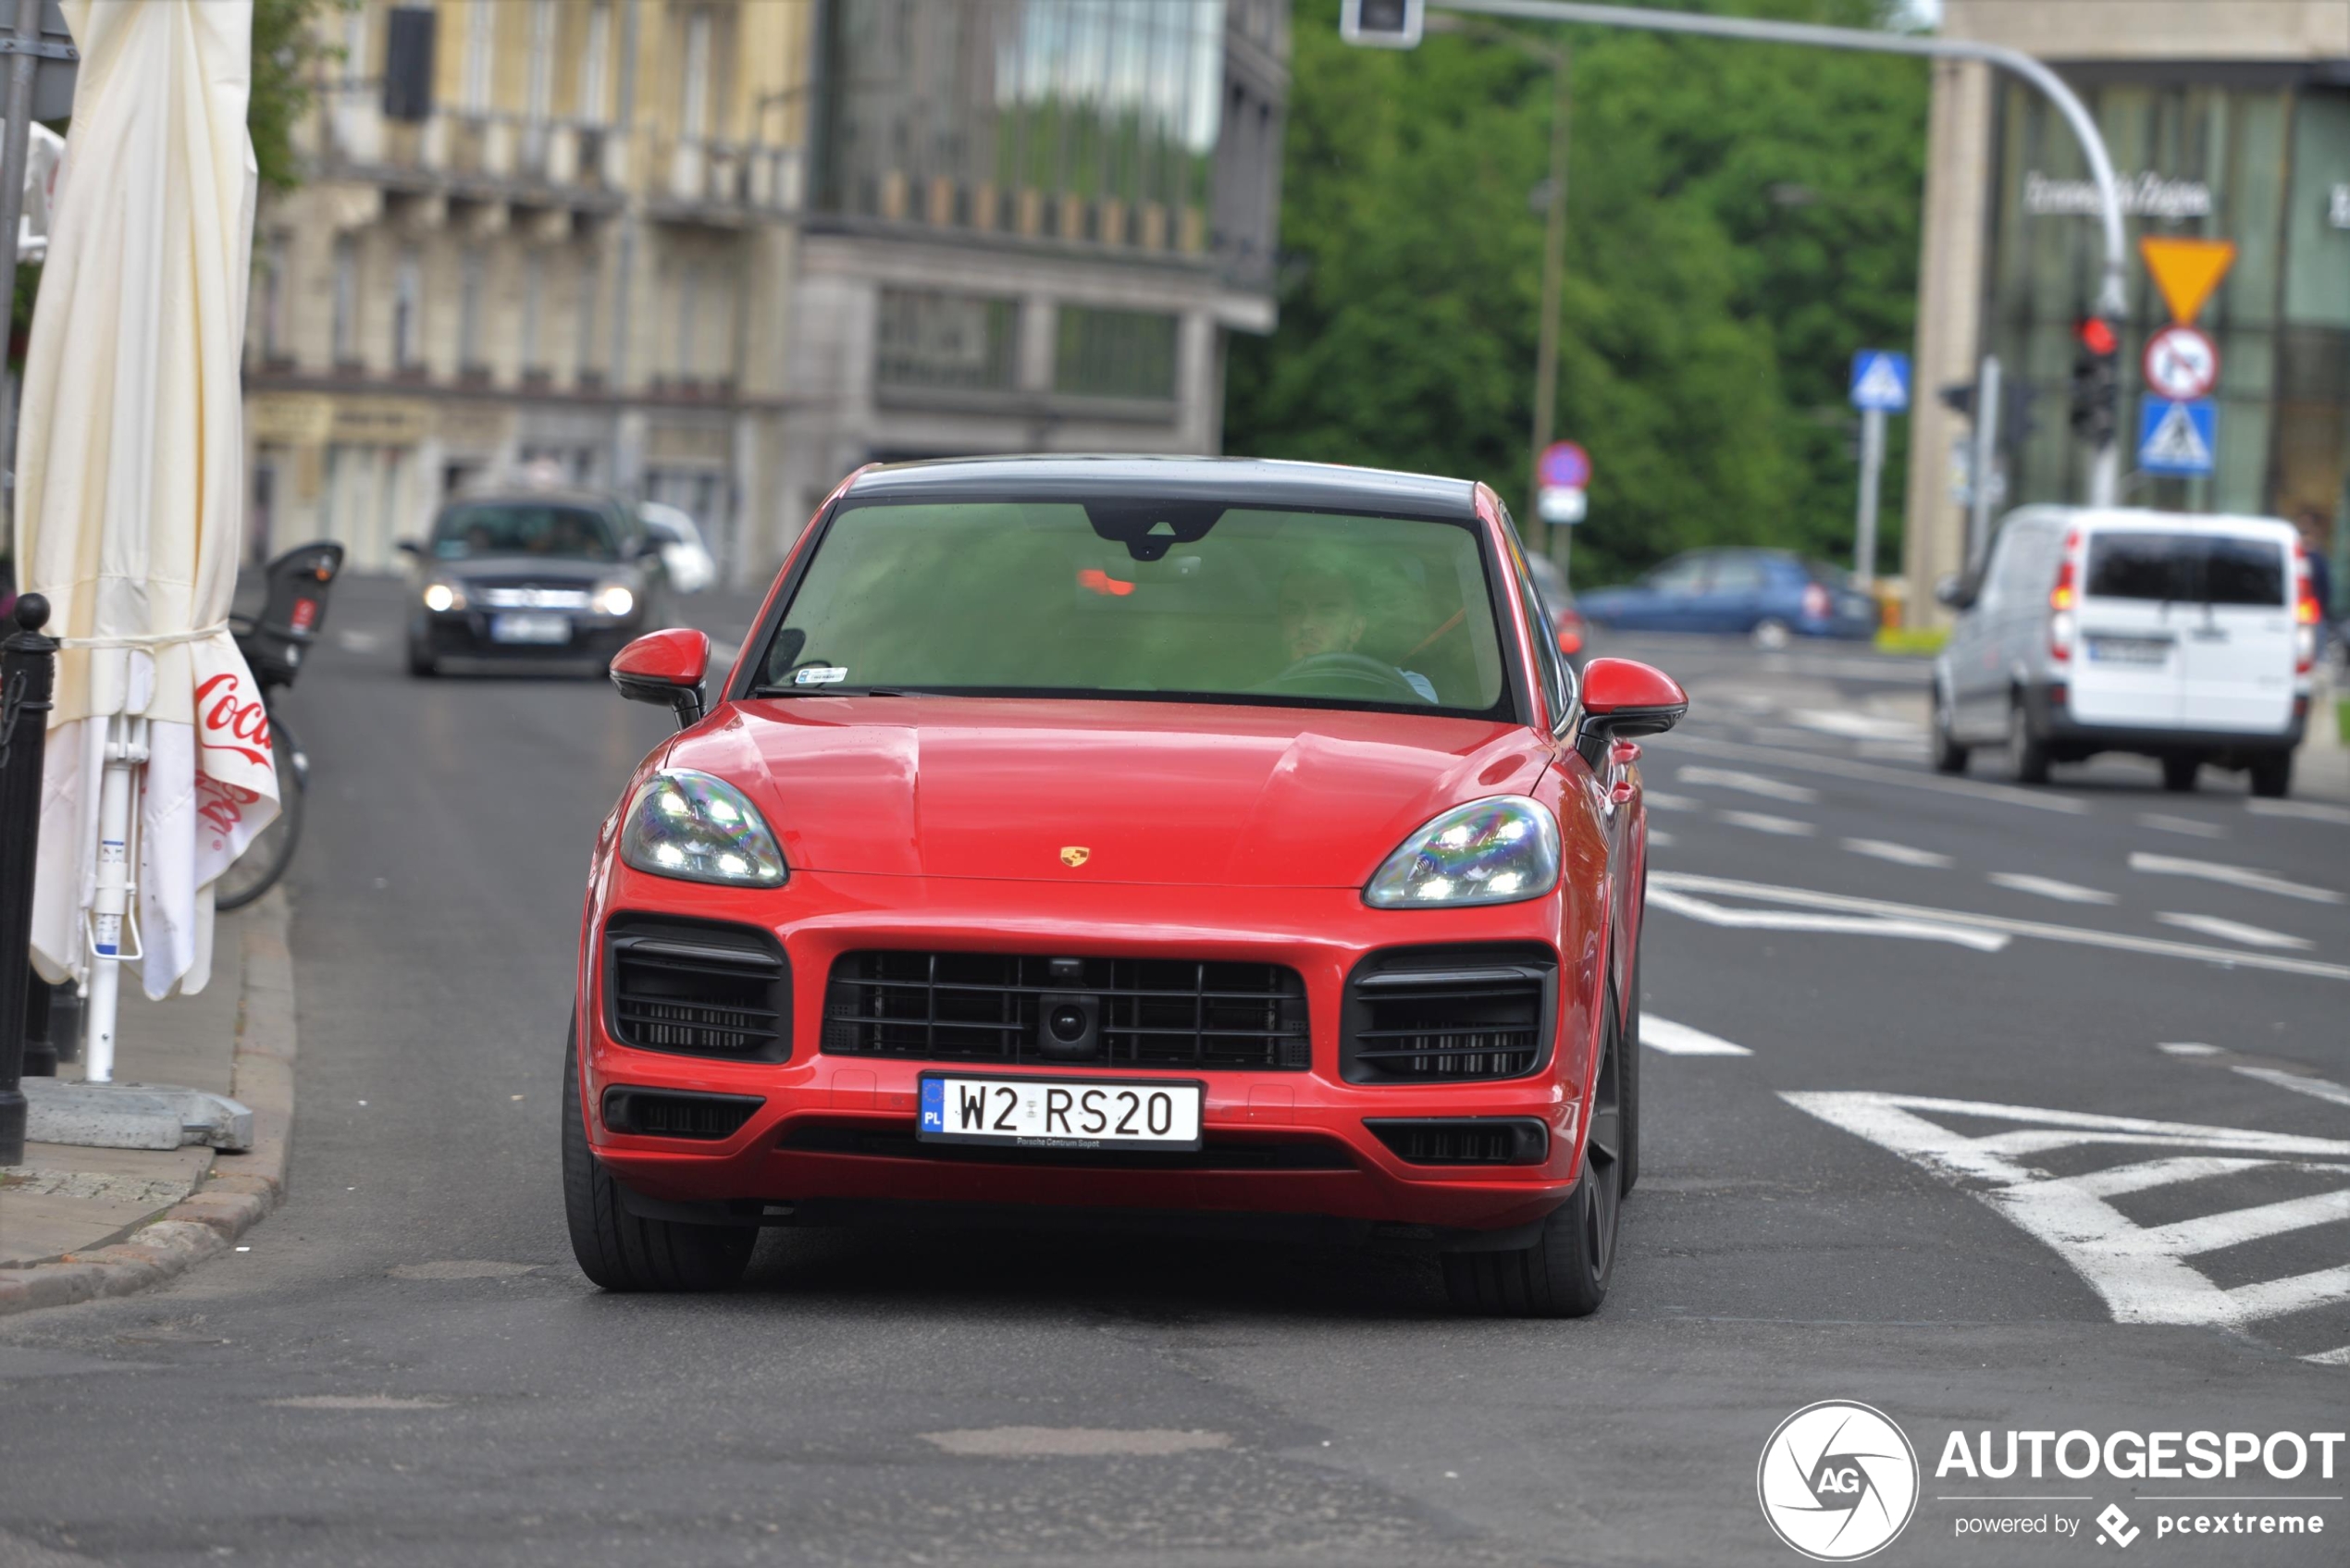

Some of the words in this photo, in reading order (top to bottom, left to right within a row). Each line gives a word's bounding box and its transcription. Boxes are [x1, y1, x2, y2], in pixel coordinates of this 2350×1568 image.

[959, 1084, 1019, 1130] W2
[1045, 1088, 1172, 1136] RS20
[924, 1111, 941, 1125] PL
[1017, 1137, 1045, 1146] Porsche
[1046, 1138, 1077, 1147] Centrum
[1078, 1139, 1100, 1149] Sopot
